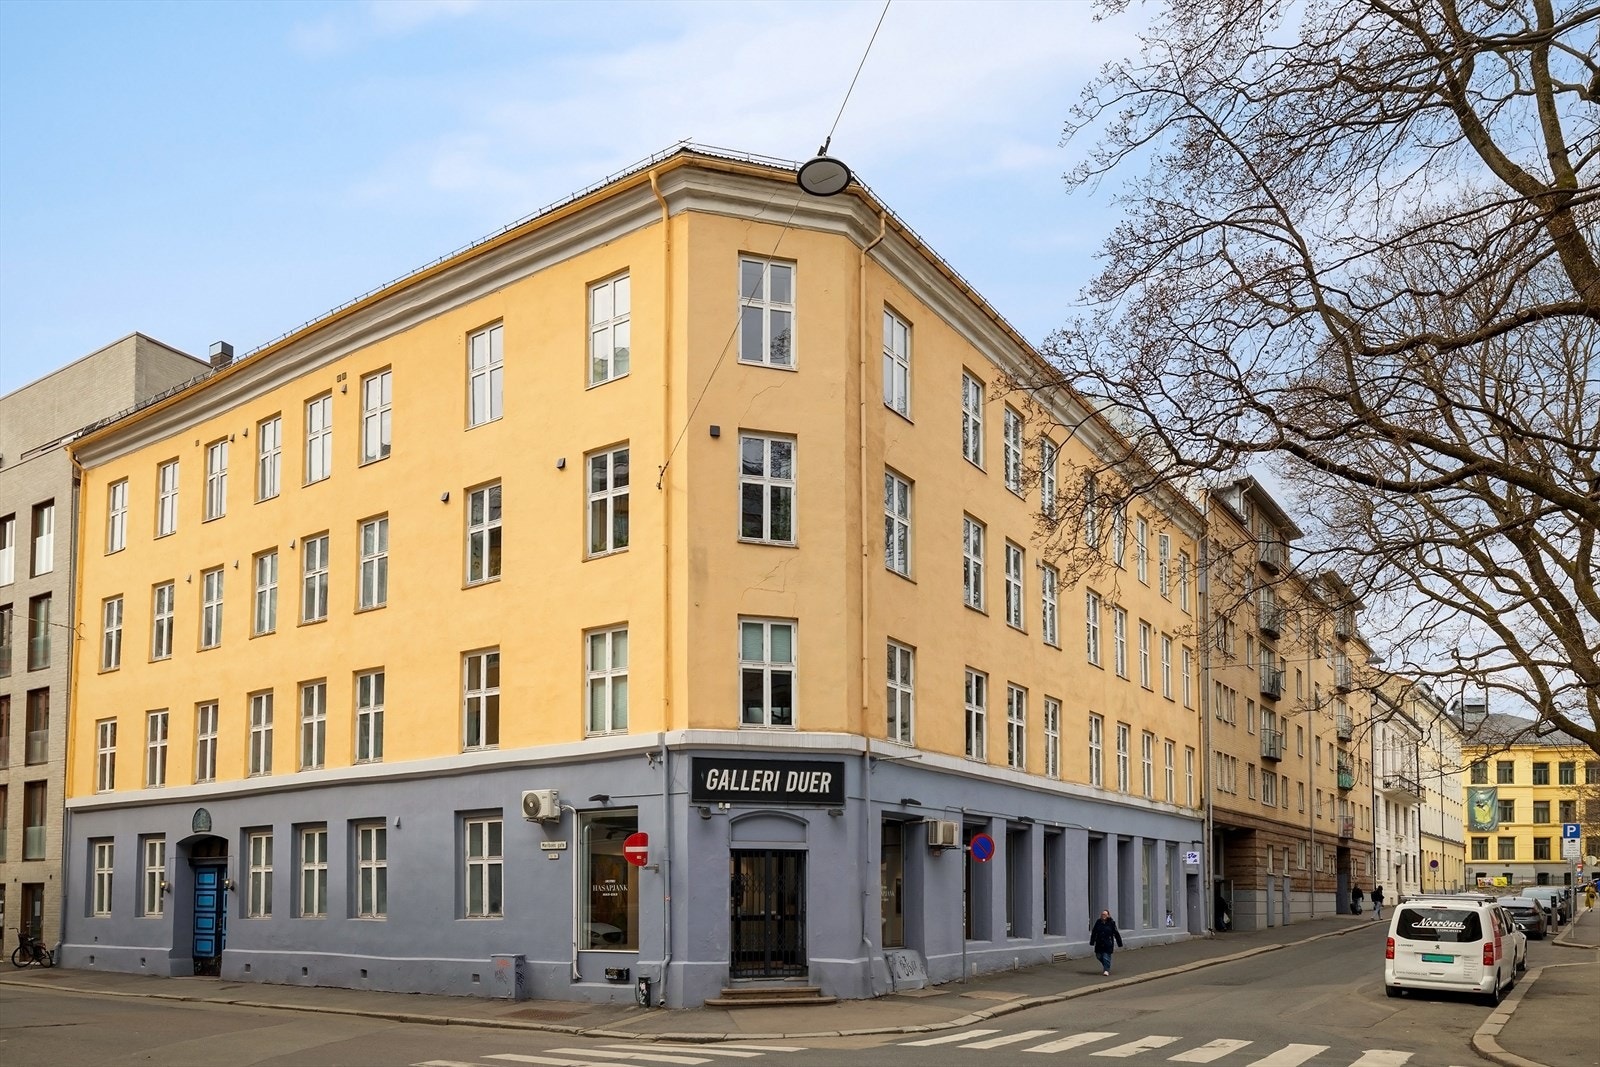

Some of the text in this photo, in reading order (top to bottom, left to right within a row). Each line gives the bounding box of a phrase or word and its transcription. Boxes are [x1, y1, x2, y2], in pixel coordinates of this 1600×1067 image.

[706, 768, 832, 793] GALLERI DUER
[1566, 825, 1577, 837] P
